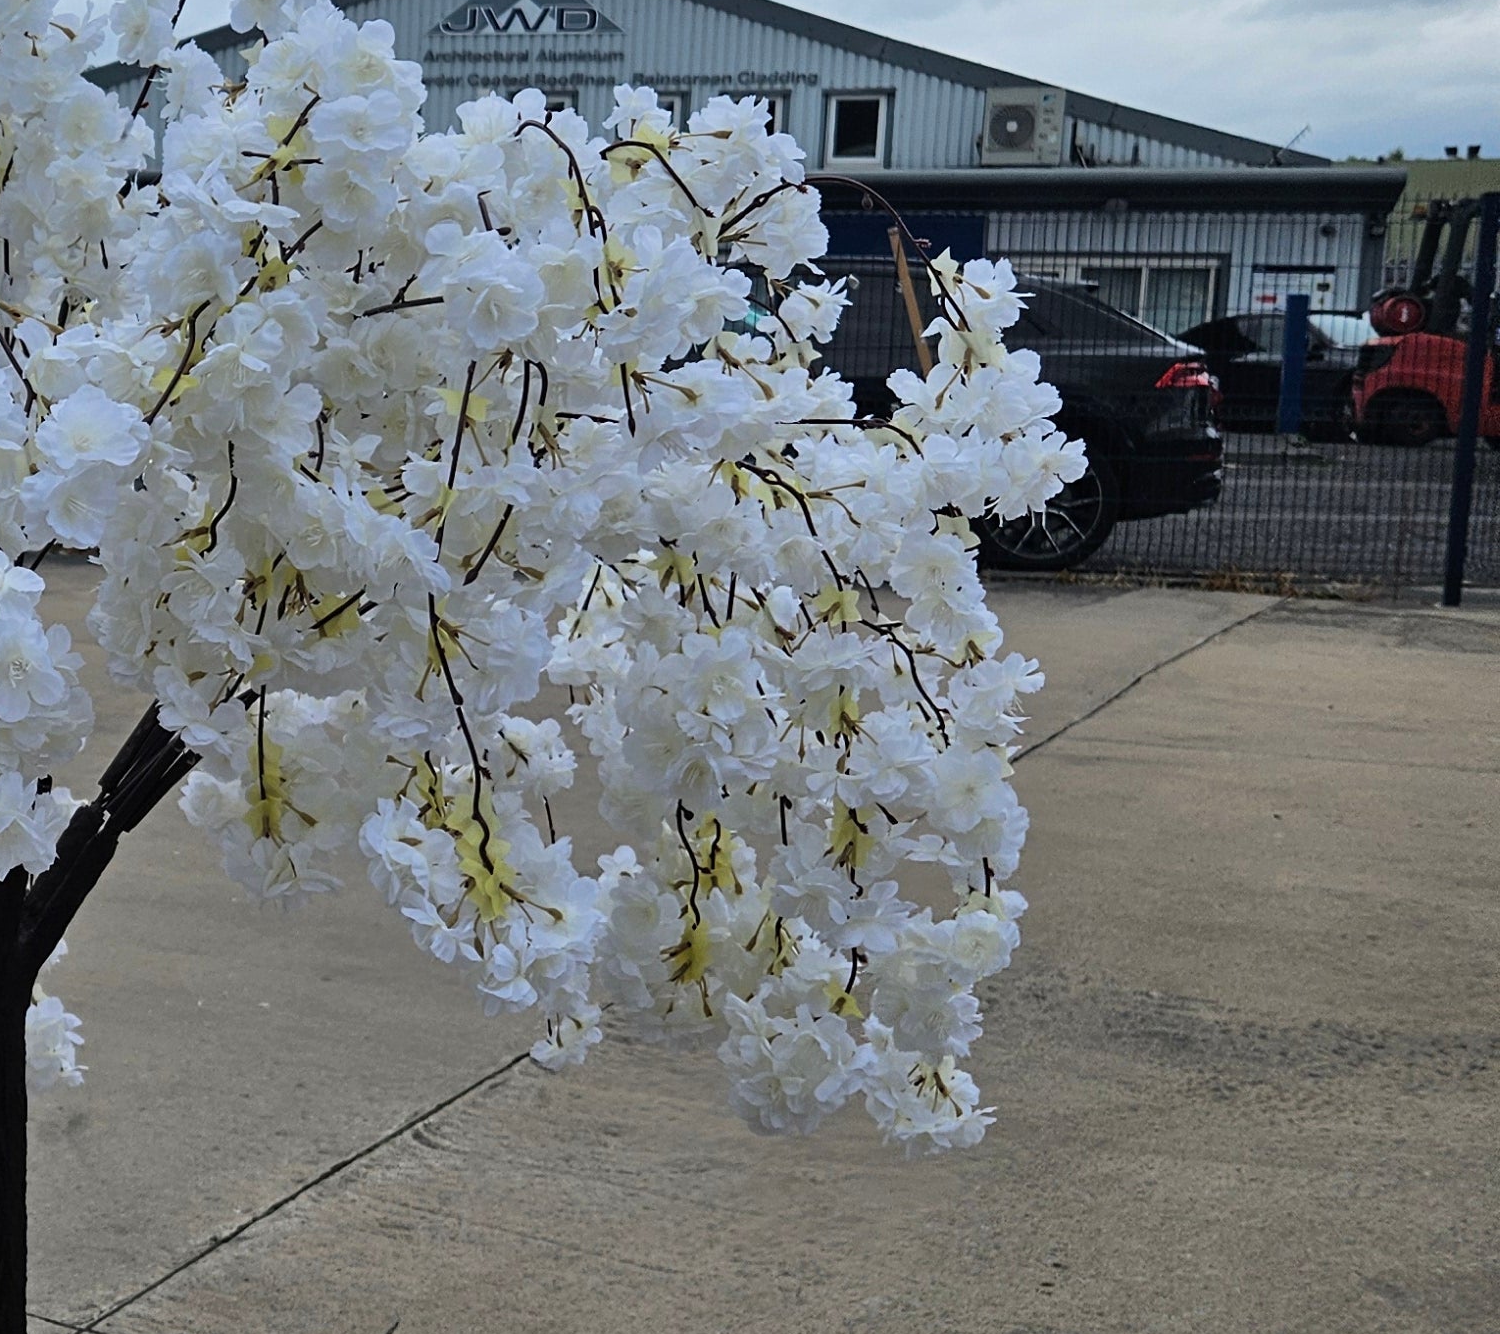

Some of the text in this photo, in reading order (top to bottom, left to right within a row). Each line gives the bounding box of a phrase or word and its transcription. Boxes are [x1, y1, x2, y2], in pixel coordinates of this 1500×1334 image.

[440, 6, 598, 35] JWD
[423, 49, 624, 63] Architectural Aluminium
[467, 73, 529, 87] Coated
[632, 72, 732, 86] Rainscreen
[737, 70, 819, 86] Cladding
